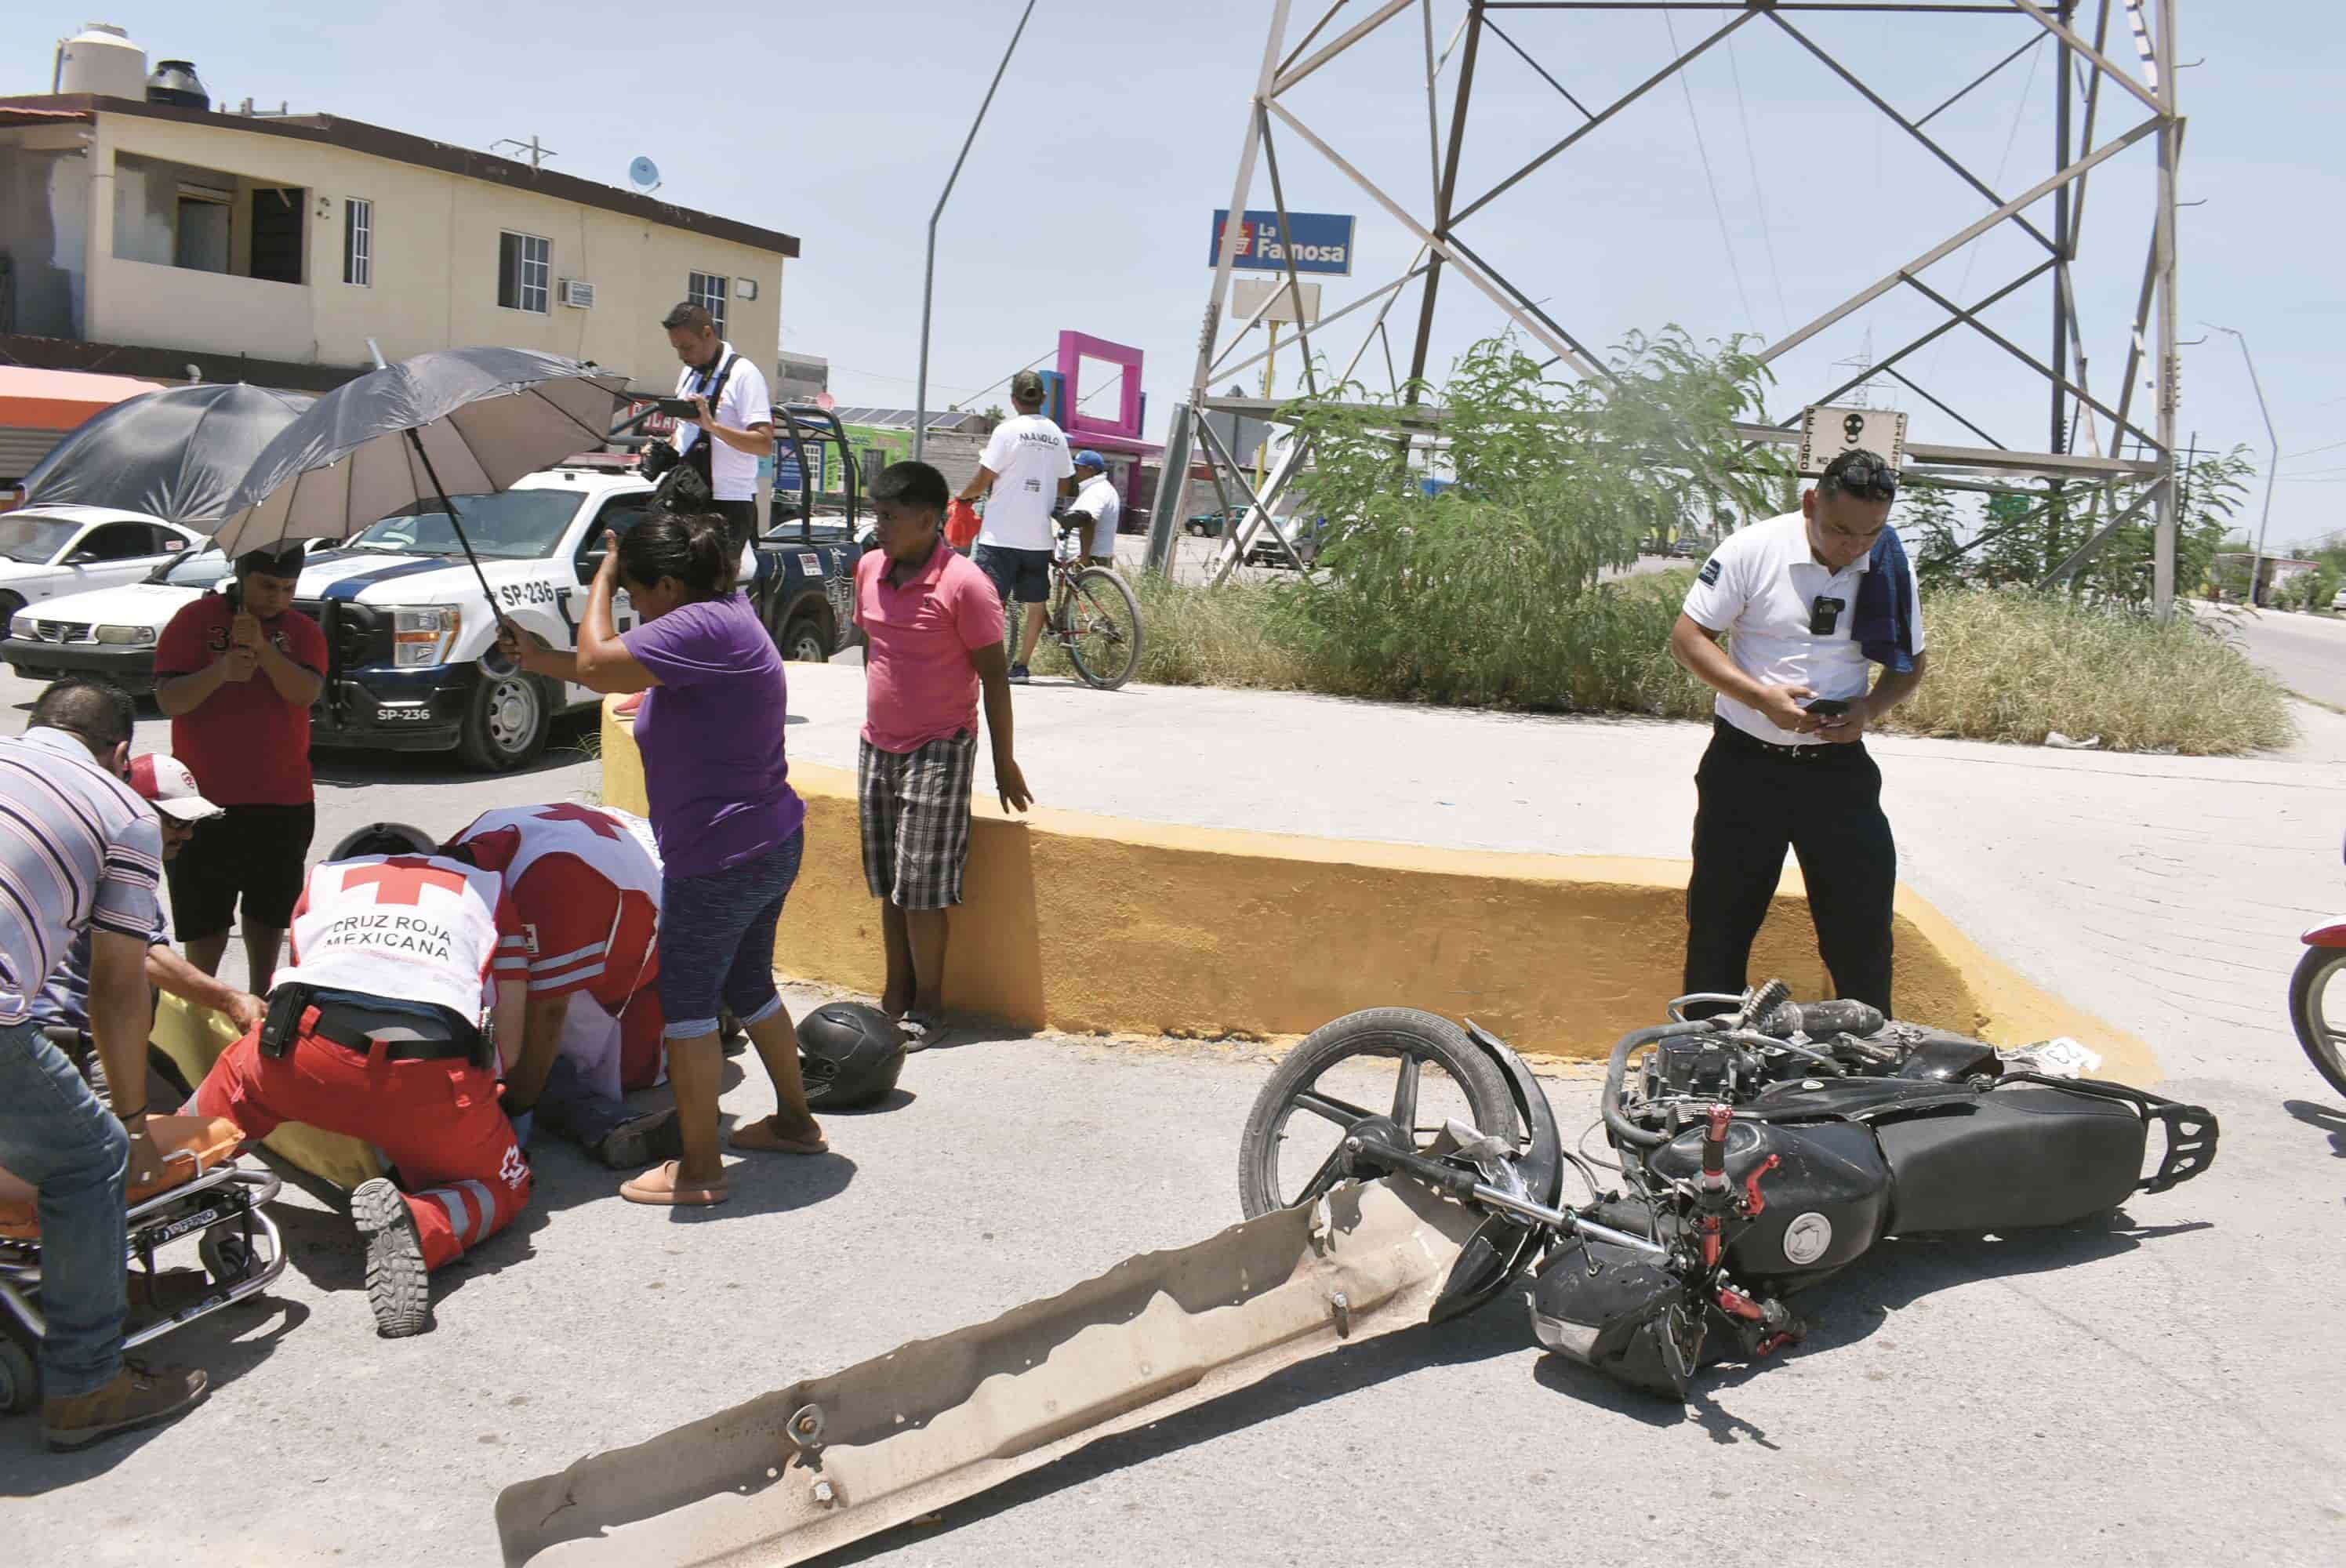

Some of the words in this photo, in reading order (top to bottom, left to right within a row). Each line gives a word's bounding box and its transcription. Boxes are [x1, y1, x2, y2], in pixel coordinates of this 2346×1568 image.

[1258, 223, 1276, 237] La
[501, 579, 554, 607] SP-236
[377, 708, 431, 720] SP-236
[333, 915, 390, 933] CRUZ
[395, 916, 452, 946] ROJA
[324, 932, 450, 962] MEXICANA
